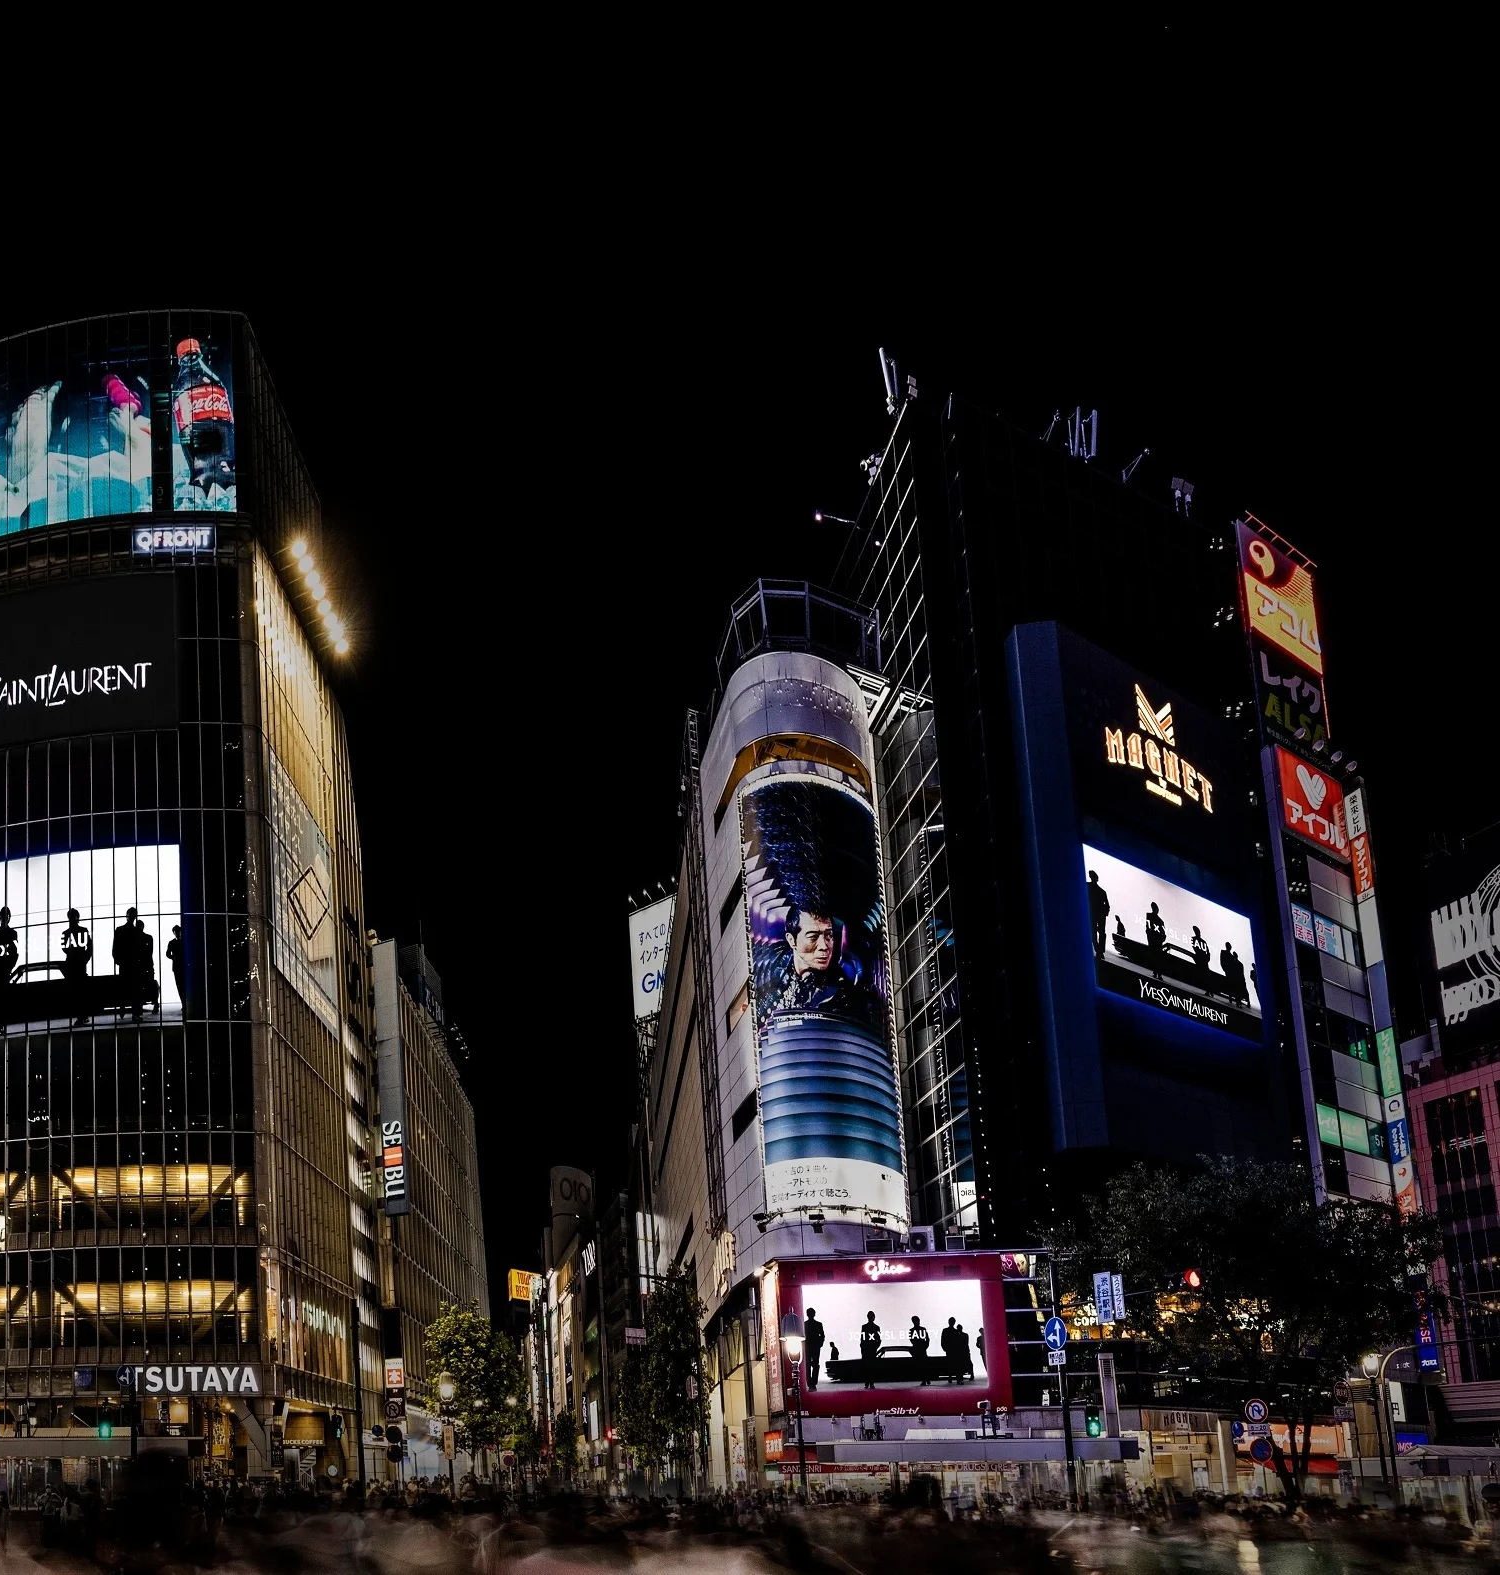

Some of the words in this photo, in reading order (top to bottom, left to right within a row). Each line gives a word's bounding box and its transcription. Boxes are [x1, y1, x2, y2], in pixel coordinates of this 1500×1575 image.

[136, 528, 211, 552] QFRONT
[1254, 583, 1322, 655] アコム
[1259, 650, 1322, 714] レイク
[1105, 726, 1213, 814] MAGNET
[1286, 797, 1346, 850] アイフル
[1355, 849, 1371, 892] アイフル
[639, 923, 666, 946] すべての
[1162, 924, 1181, 941] YSL
[1183, 934, 1217, 955] BEAUTY
[382, 1120, 405, 1199] SEIBU
[863, 1259, 912, 1281] Glico
[1100, 1276, 1112, 1320] 渋谷駅前
[877, 1330, 898, 1340] YSL
[900, 1328, 940, 1340] BEAUTY
[134, 1366, 259, 1393] TSUTAYA
[1163, 1411, 1199, 1428] MAGNET
[782, 1465, 822, 1473] SANENRI
